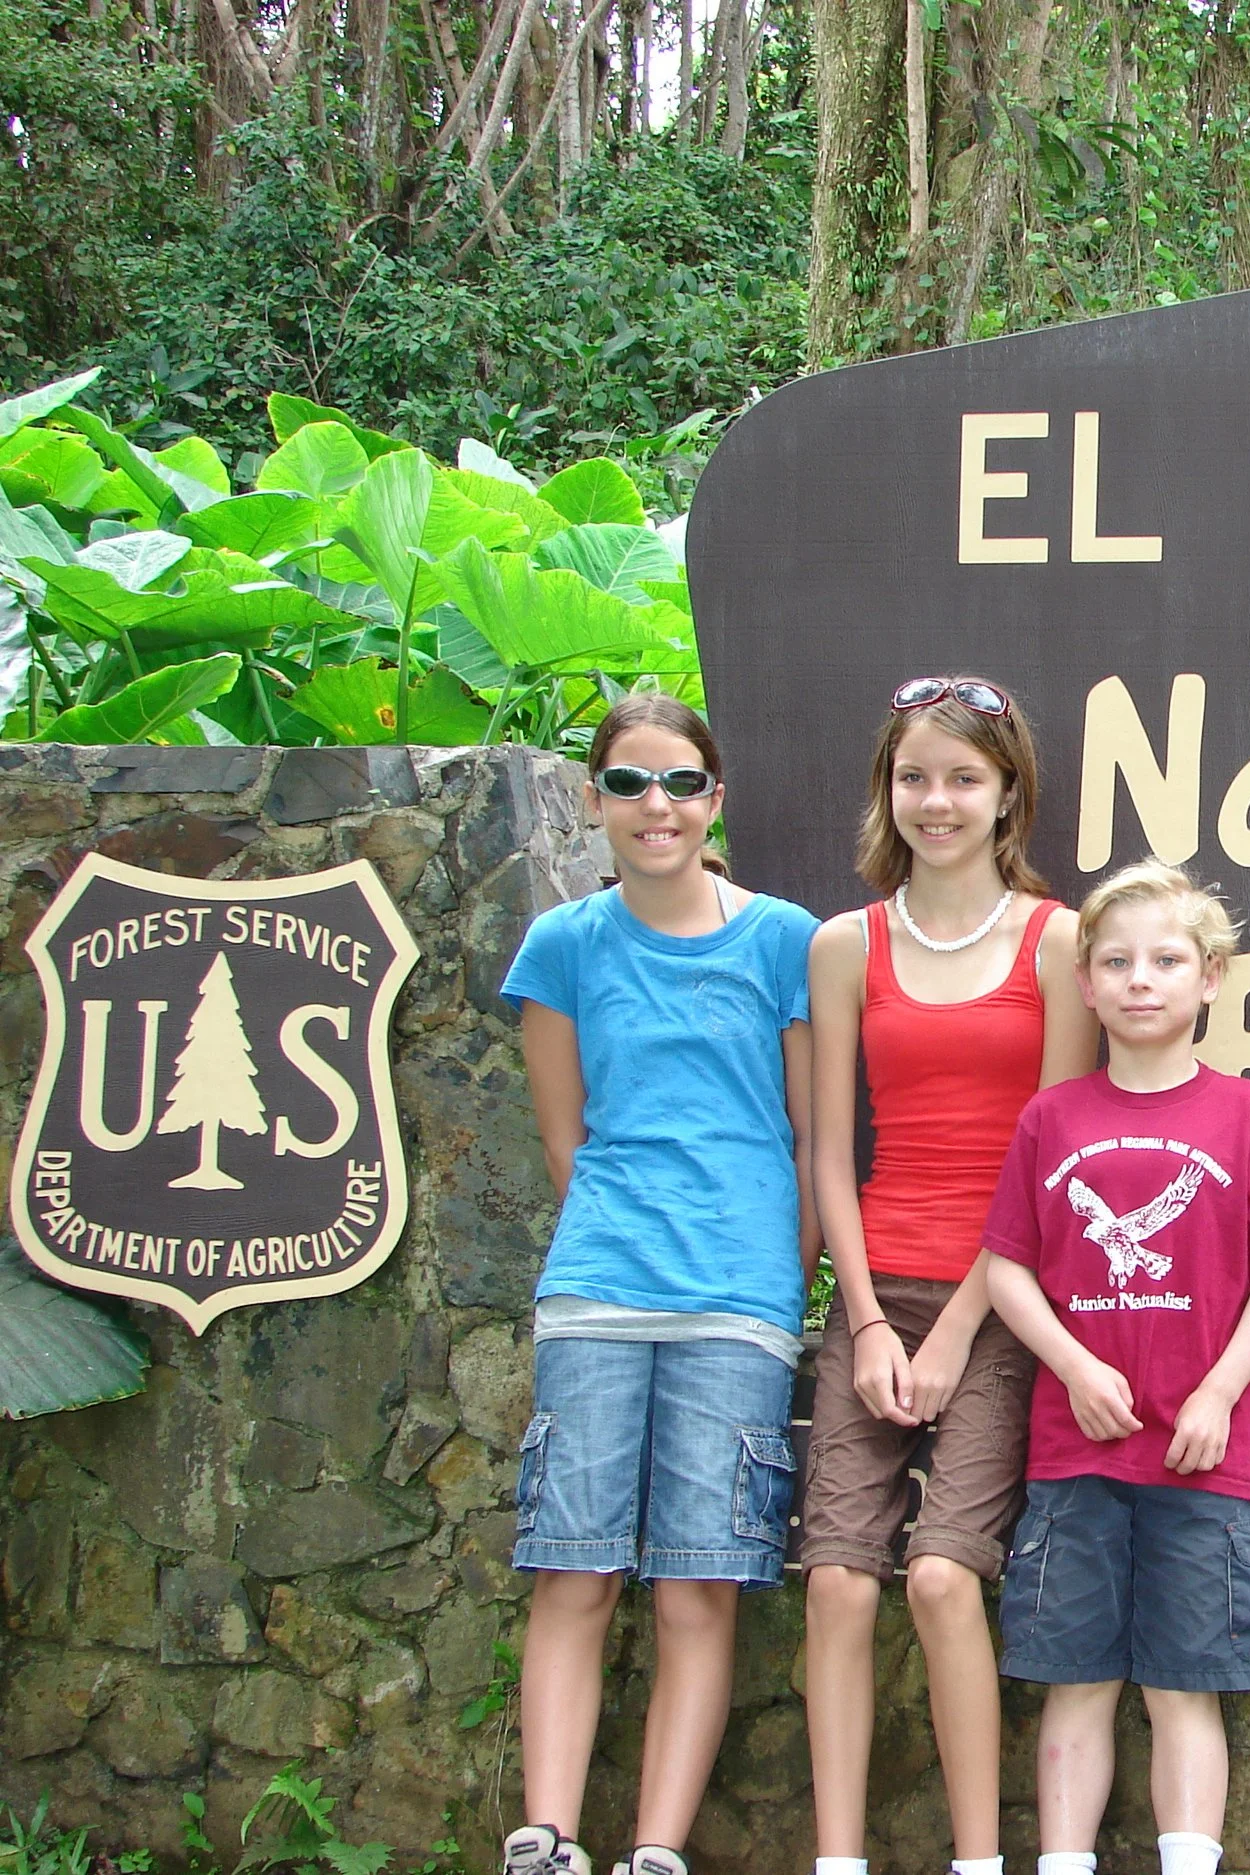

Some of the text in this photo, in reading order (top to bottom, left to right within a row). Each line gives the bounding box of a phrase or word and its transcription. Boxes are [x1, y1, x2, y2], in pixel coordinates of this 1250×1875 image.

[958, 411, 1163, 565] EL
[71, 905, 372, 987] FOREST SERVICE
[34, 1150, 382, 1278] DEPARTMENT OF AGRICULTURE
[1068, 1294, 1117, 1312] Junior
